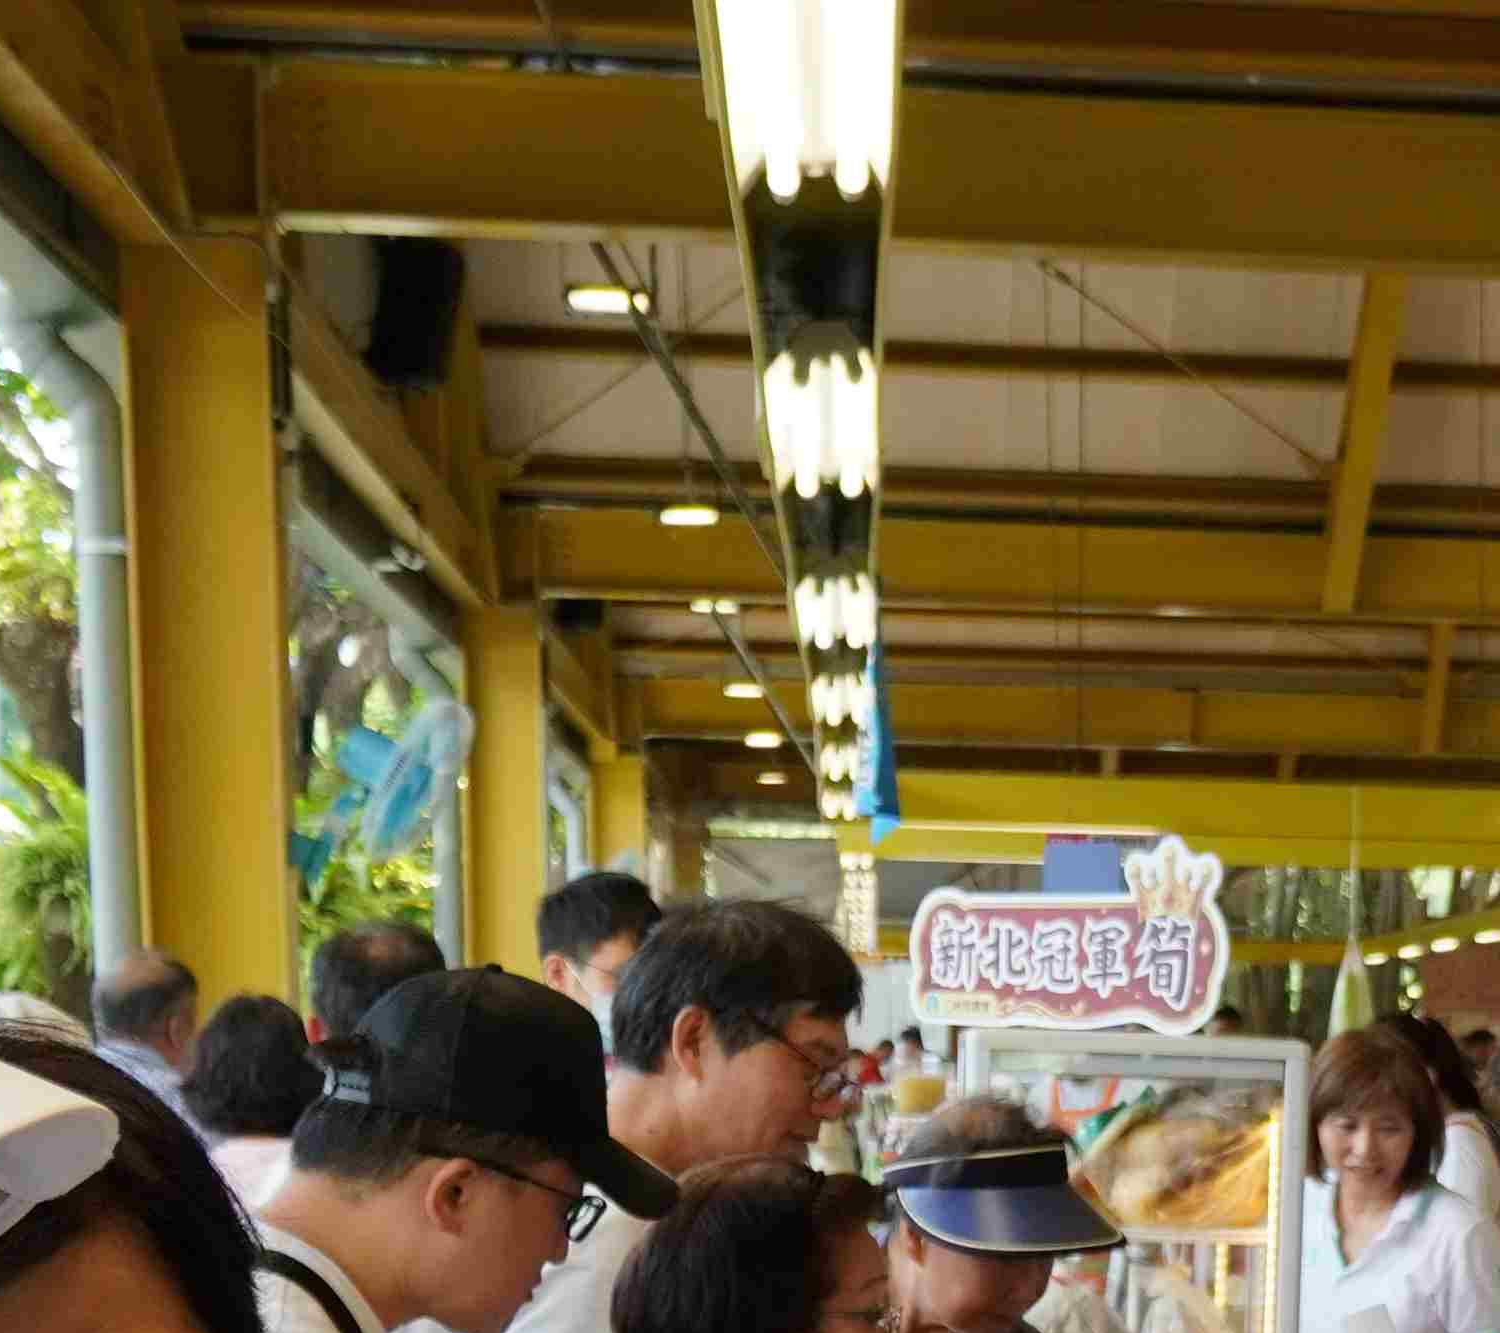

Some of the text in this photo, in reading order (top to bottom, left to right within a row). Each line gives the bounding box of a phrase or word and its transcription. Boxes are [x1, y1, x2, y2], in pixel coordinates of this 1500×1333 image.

[931, 914, 1194, 1009] 新北冠軍筍
